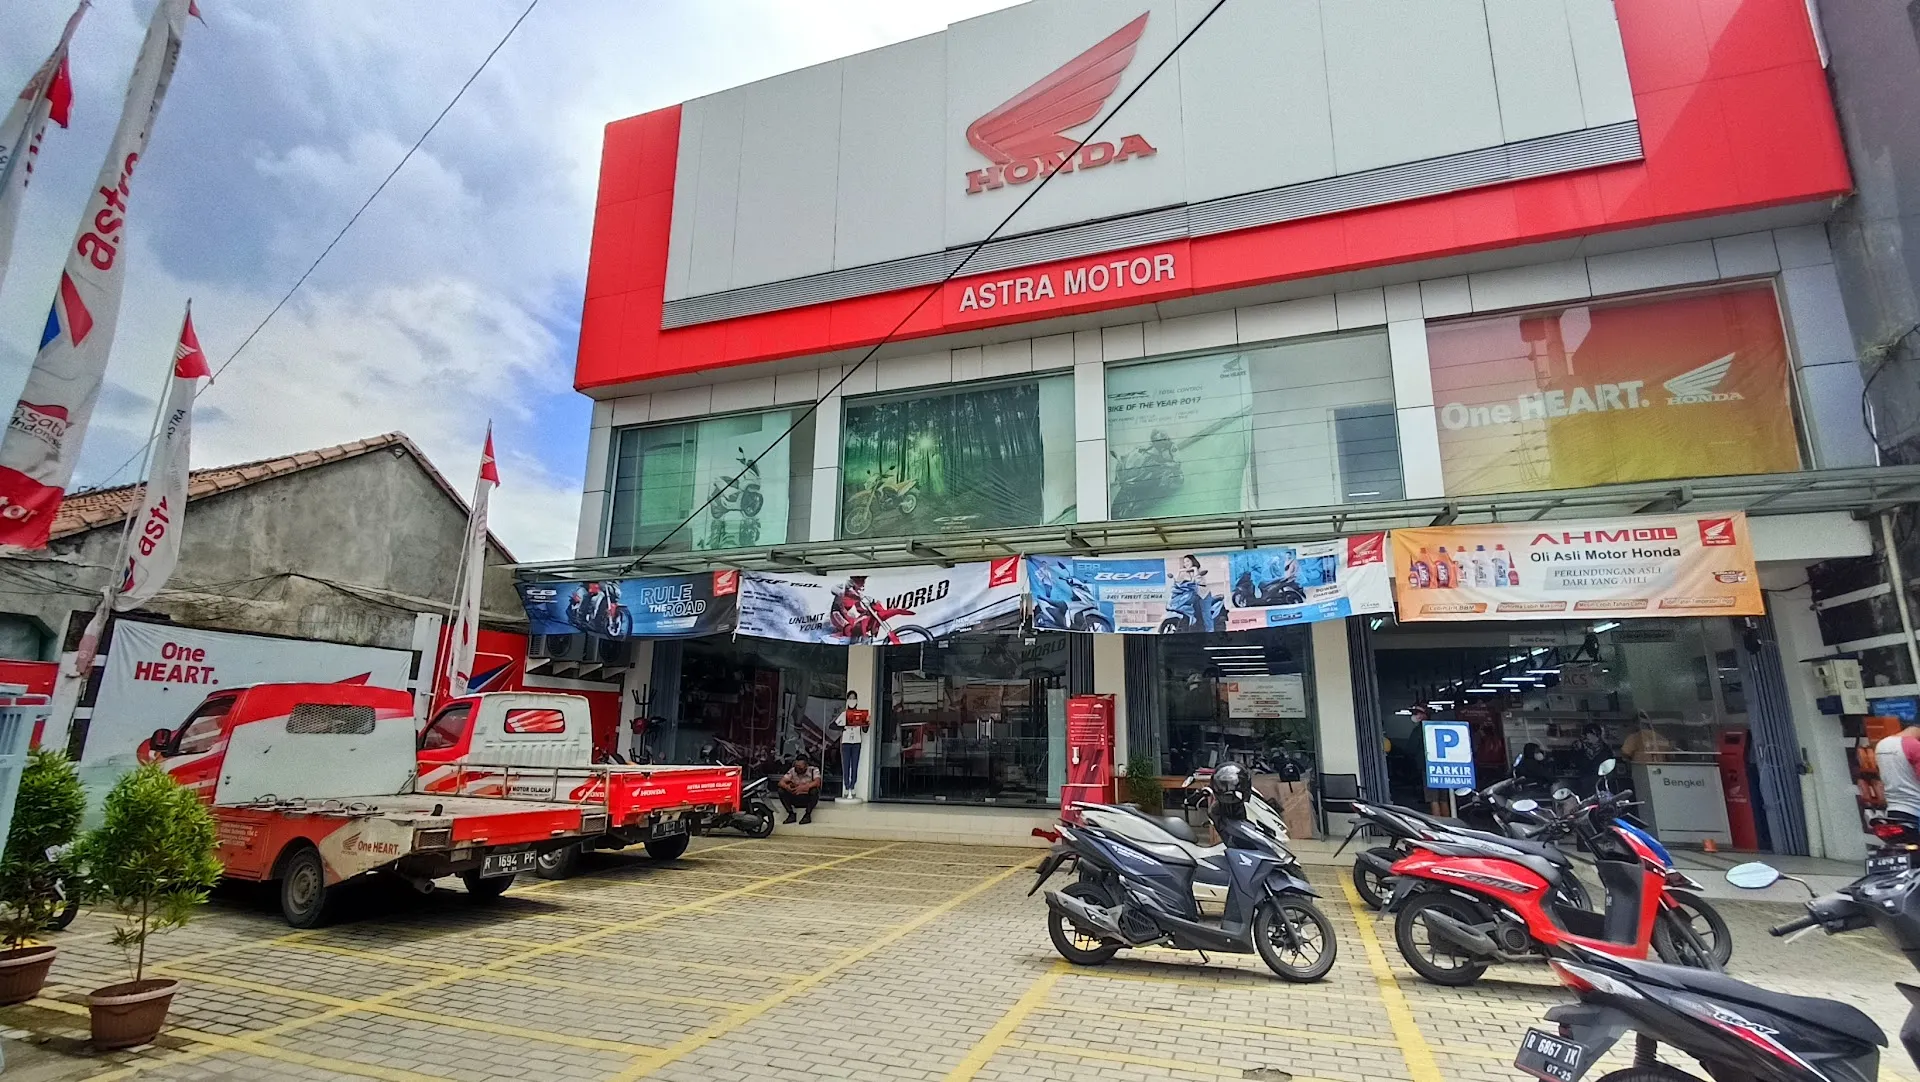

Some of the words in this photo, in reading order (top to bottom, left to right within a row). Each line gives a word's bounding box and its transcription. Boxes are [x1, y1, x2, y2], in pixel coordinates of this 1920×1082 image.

[966, 134, 1158, 195] HONDA
[959, 274, 1055, 312] ASTRA
[1063, 252, 1176, 296] MOTOR
[1108, 404, 1124, 413] BIKE
[1126, 403, 1137, 411] OF
[1139, 401, 1155, 410] THE
[1156, 398, 1178, 408] YEAR
[1179, 396, 1202, 406] 2017
[1441, 401, 1512, 431] One
[1518, 381, 1650, 421] HEART.
[1666, 392, 1745, 406] HONDA
[1530, 552, 1550, 562] Oli
[1553, 550, 1581, 562] Asli
[1586, 549, 1628, 561] Motor
[1632, 547, 1681, 559] Honda
[1554, 567, 1636, 577] PERLINDUNGAN
[1638, 566, 1662, 575] ASLI
[1562, 578, 1587, 587] DARI
[1590, 577, 1618, 585] YANG
[1620, 576, 1647, 585] AHLI
[641, 583, 693, 605] RULE
[886, 579, 950, 610] WORLD
[649, 604, 668, 613] THE
[664, 599, 706, 617] ROAD
[788, 613, 825, 625] UNLIMIT
[800, 622, 823, 632] YOUR
[161, 642, 206, 662] One
[134, 661, 219, 685] HEART.
[1434, 728, 1460, 759] P
[1428, 765, 1471, 776] PARKIR
[1444, 777, 1472, 785] MASUK
[1663, 777, 1705, 788] Bengkel
[512, 785, 530, 793] MOTOR
[530, 786, 552, 794] CILACAP
[640, 788, 666, 797] HONDA
[357, 840, 372, 852] One
[372, 841, 400, 855] HEART.
[484, 857, 491, 870] R
[498, 854, 518, 867] 1694
[523, 852, 535, 865] PF
[1526, 1034, 1537, 1049] R
[1537, 1038, 1562, 1058] 6867
[1563, 1047, 1579, 1066] IK
